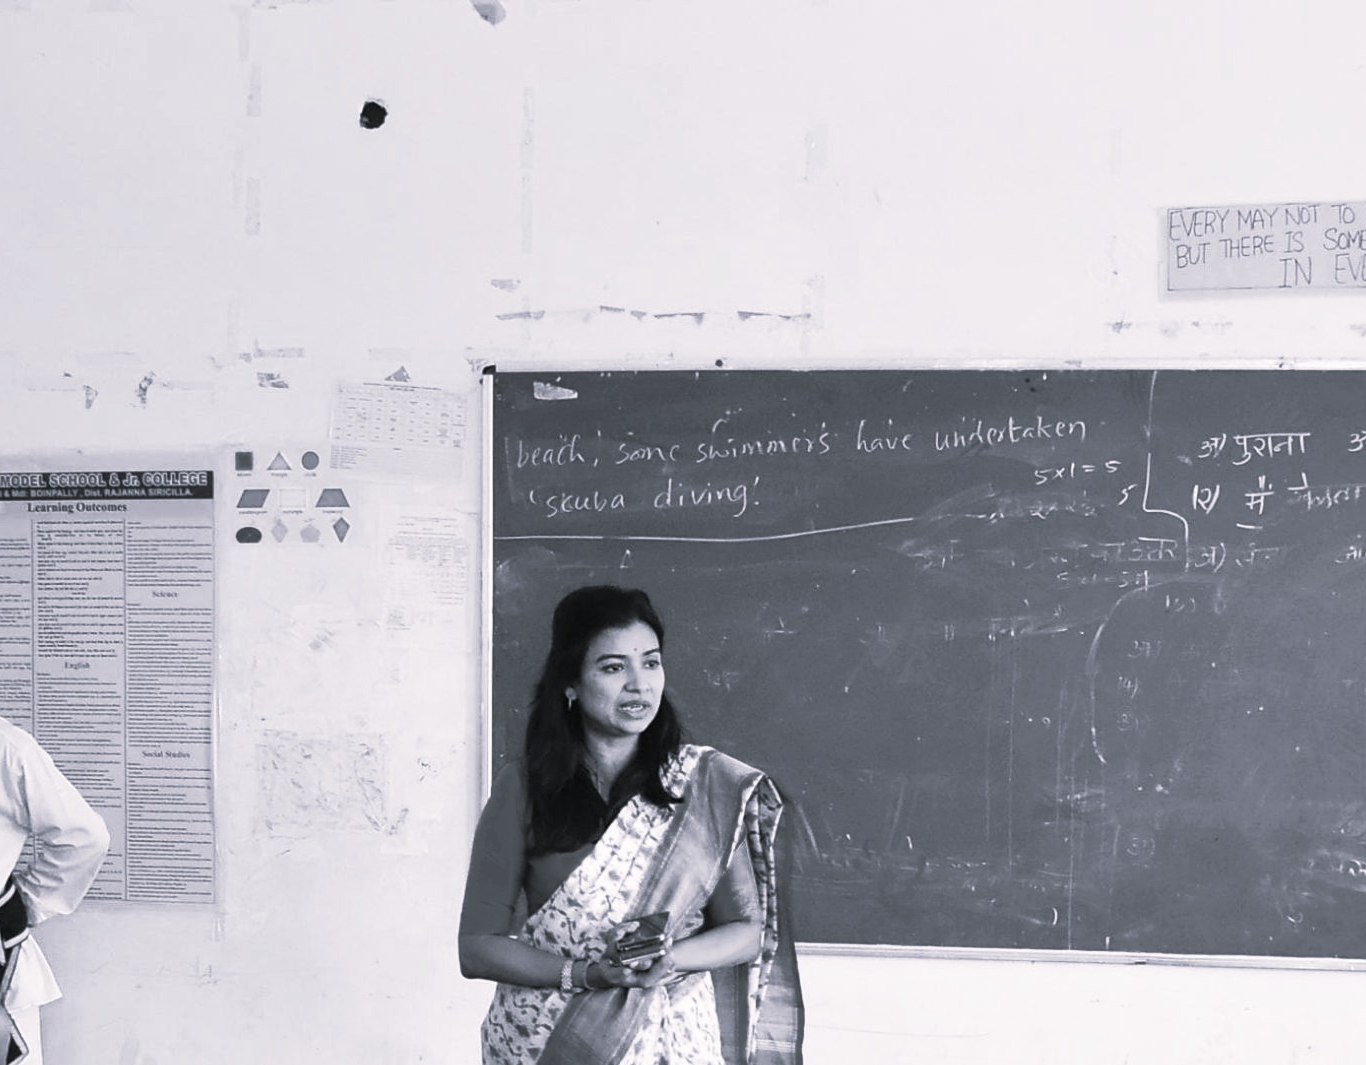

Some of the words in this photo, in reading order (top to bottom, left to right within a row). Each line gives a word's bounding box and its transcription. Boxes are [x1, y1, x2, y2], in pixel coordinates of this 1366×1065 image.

[1169, 209, 1230, 241] EVERY
[1237, 208, 1278, 230] MAY
[1285, 204, 1320, 226] NOT
[1331, 203, 1356, 224] TO
[1176, 242, 1211, 269] BUT
[1219, 235, 1274, 260] THERE
[1283, 231, 1305, 254] IS
[1279, 257, 1313, 288] IN
[857, 418, 912, 453] have
[935, 416, 1087, 451] undertaken
[48, 474, 107, 488] SCHOOL
[109, 474, 120, 487] &
[122, 473, 140, 487] Jr.
[142, 472, 208, 487] COLLEGE
[105, 489, 147, 497] RAJANNA
[27, 502, 74, 514] Learning
[76, 502, 128, 513] Outcomes
[151, 589, 179, 599] Science
[64, 660, 91, 670] English
[141, 750, 163, 760] Social
[165, 750, 191, 760] Studies
